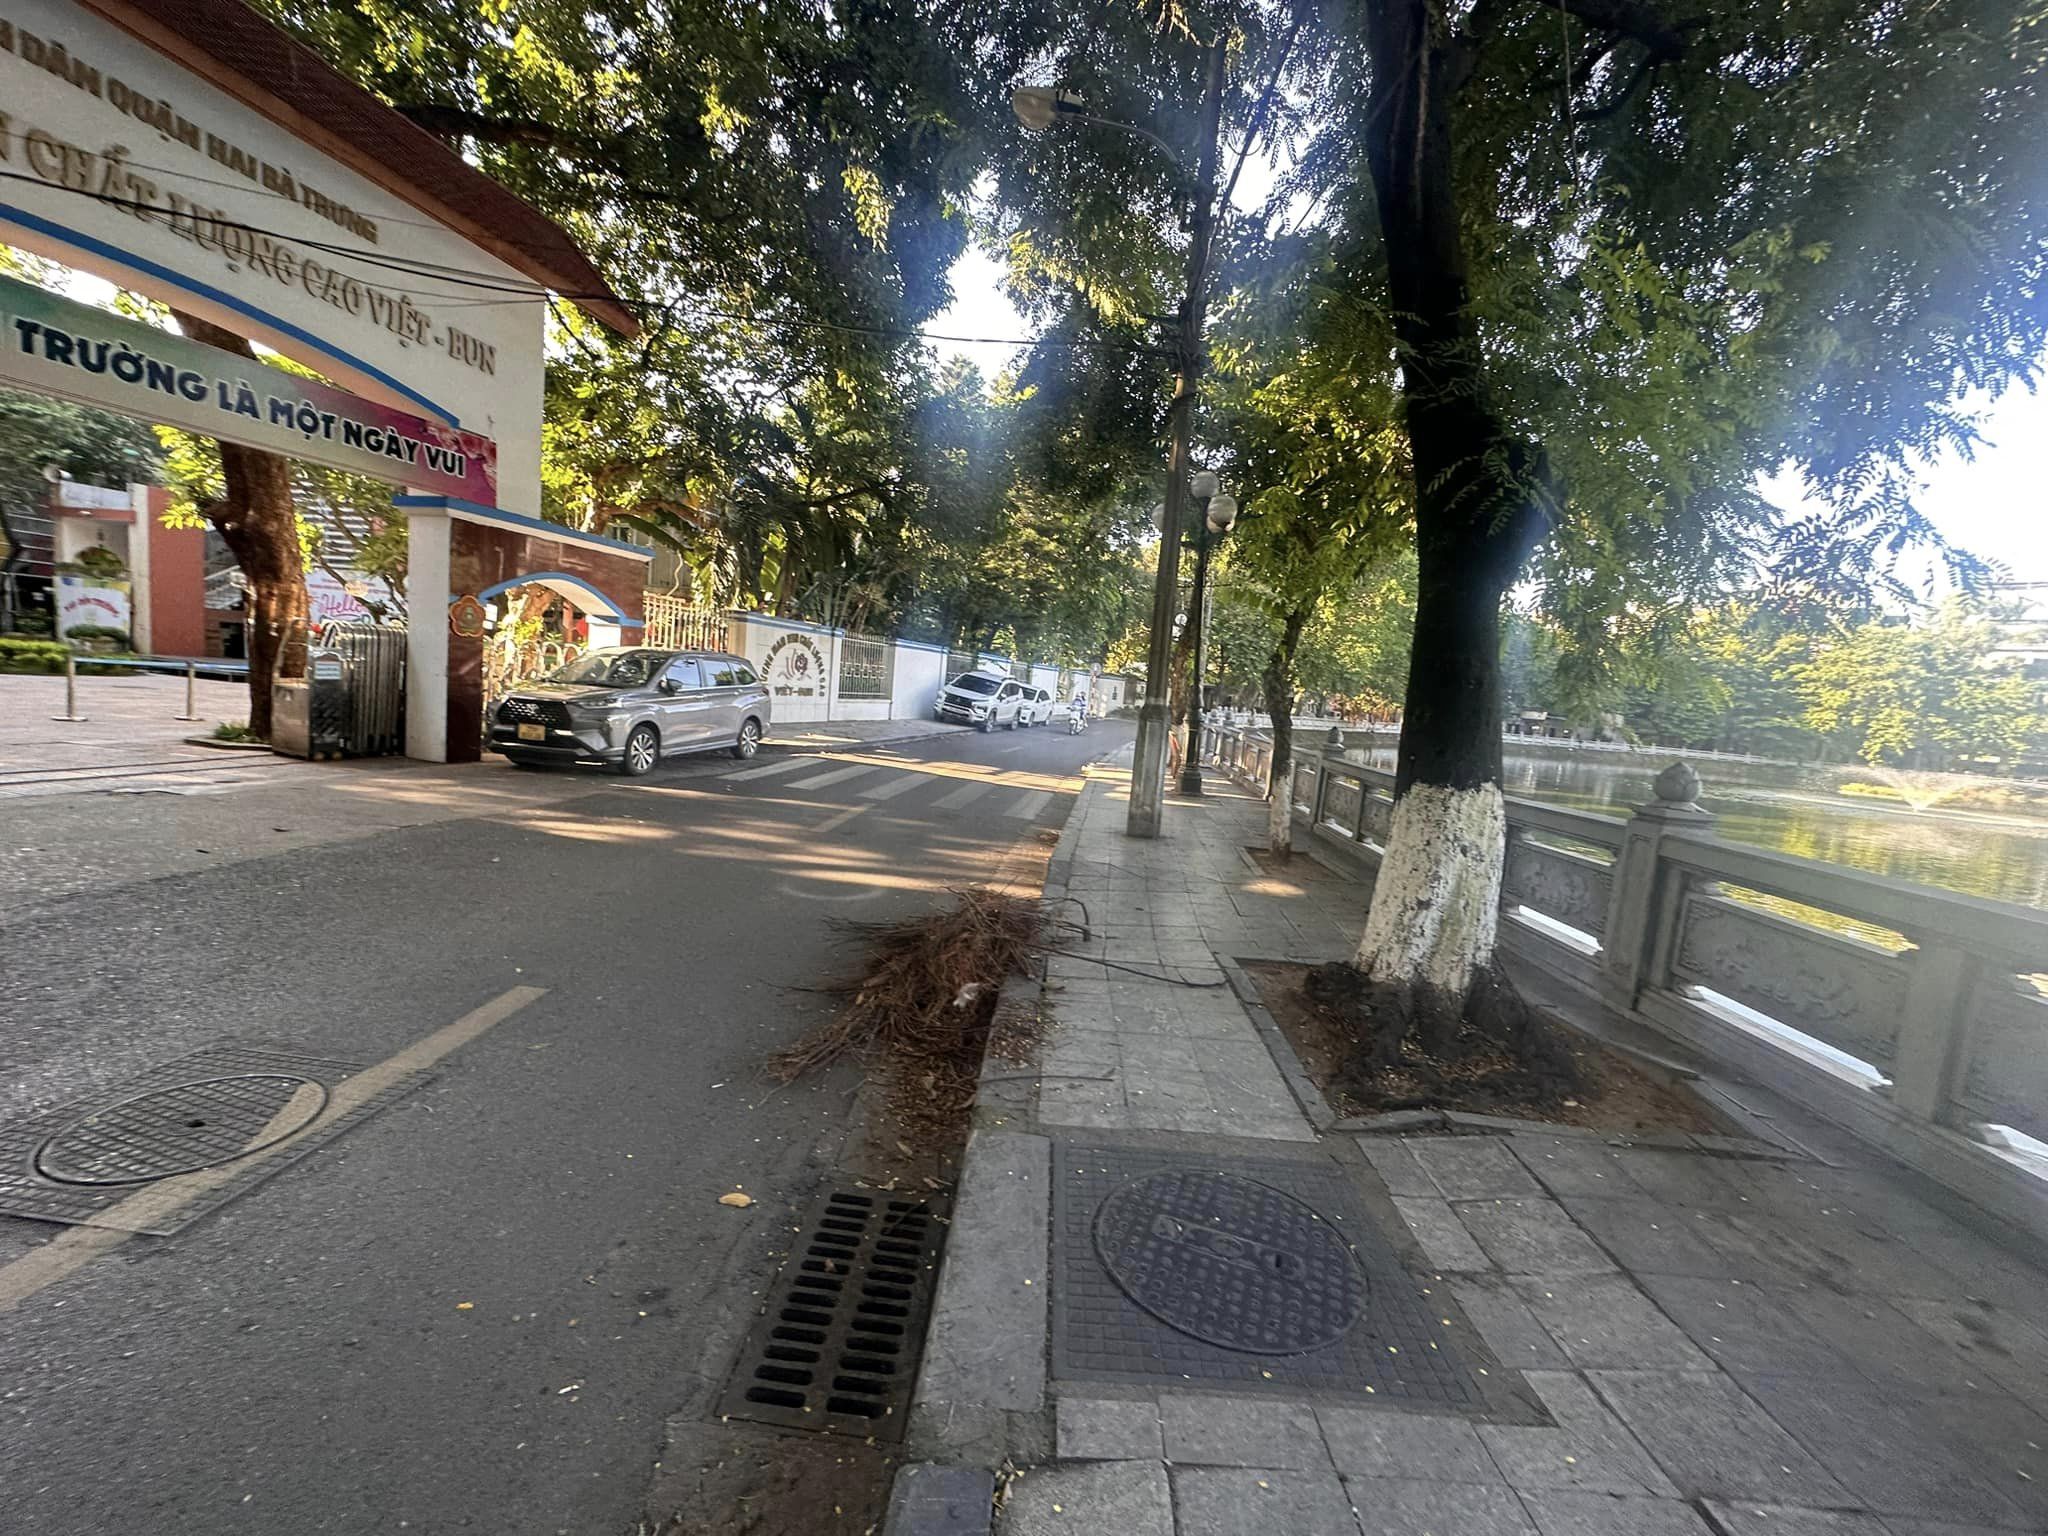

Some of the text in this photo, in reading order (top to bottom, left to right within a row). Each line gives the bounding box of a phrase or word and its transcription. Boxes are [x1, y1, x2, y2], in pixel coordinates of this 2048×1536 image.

[25, 127, 159, 224] CHẤT
[168, 191, 298, 286] LƯỢNG
[302, 257, 361, 317] CAO
[365, 286, 432, 348] VIỆT
[107, 76, 202, 152] QUẬN
[207, 132, 258, 182] HAI
[261, 161, 298, 202] BÀ
[299, 182, 379, 245] TRƯNG
[14, 317, 466, 477] TRƯỜNG LÀ MỘT NGÀY VUI
